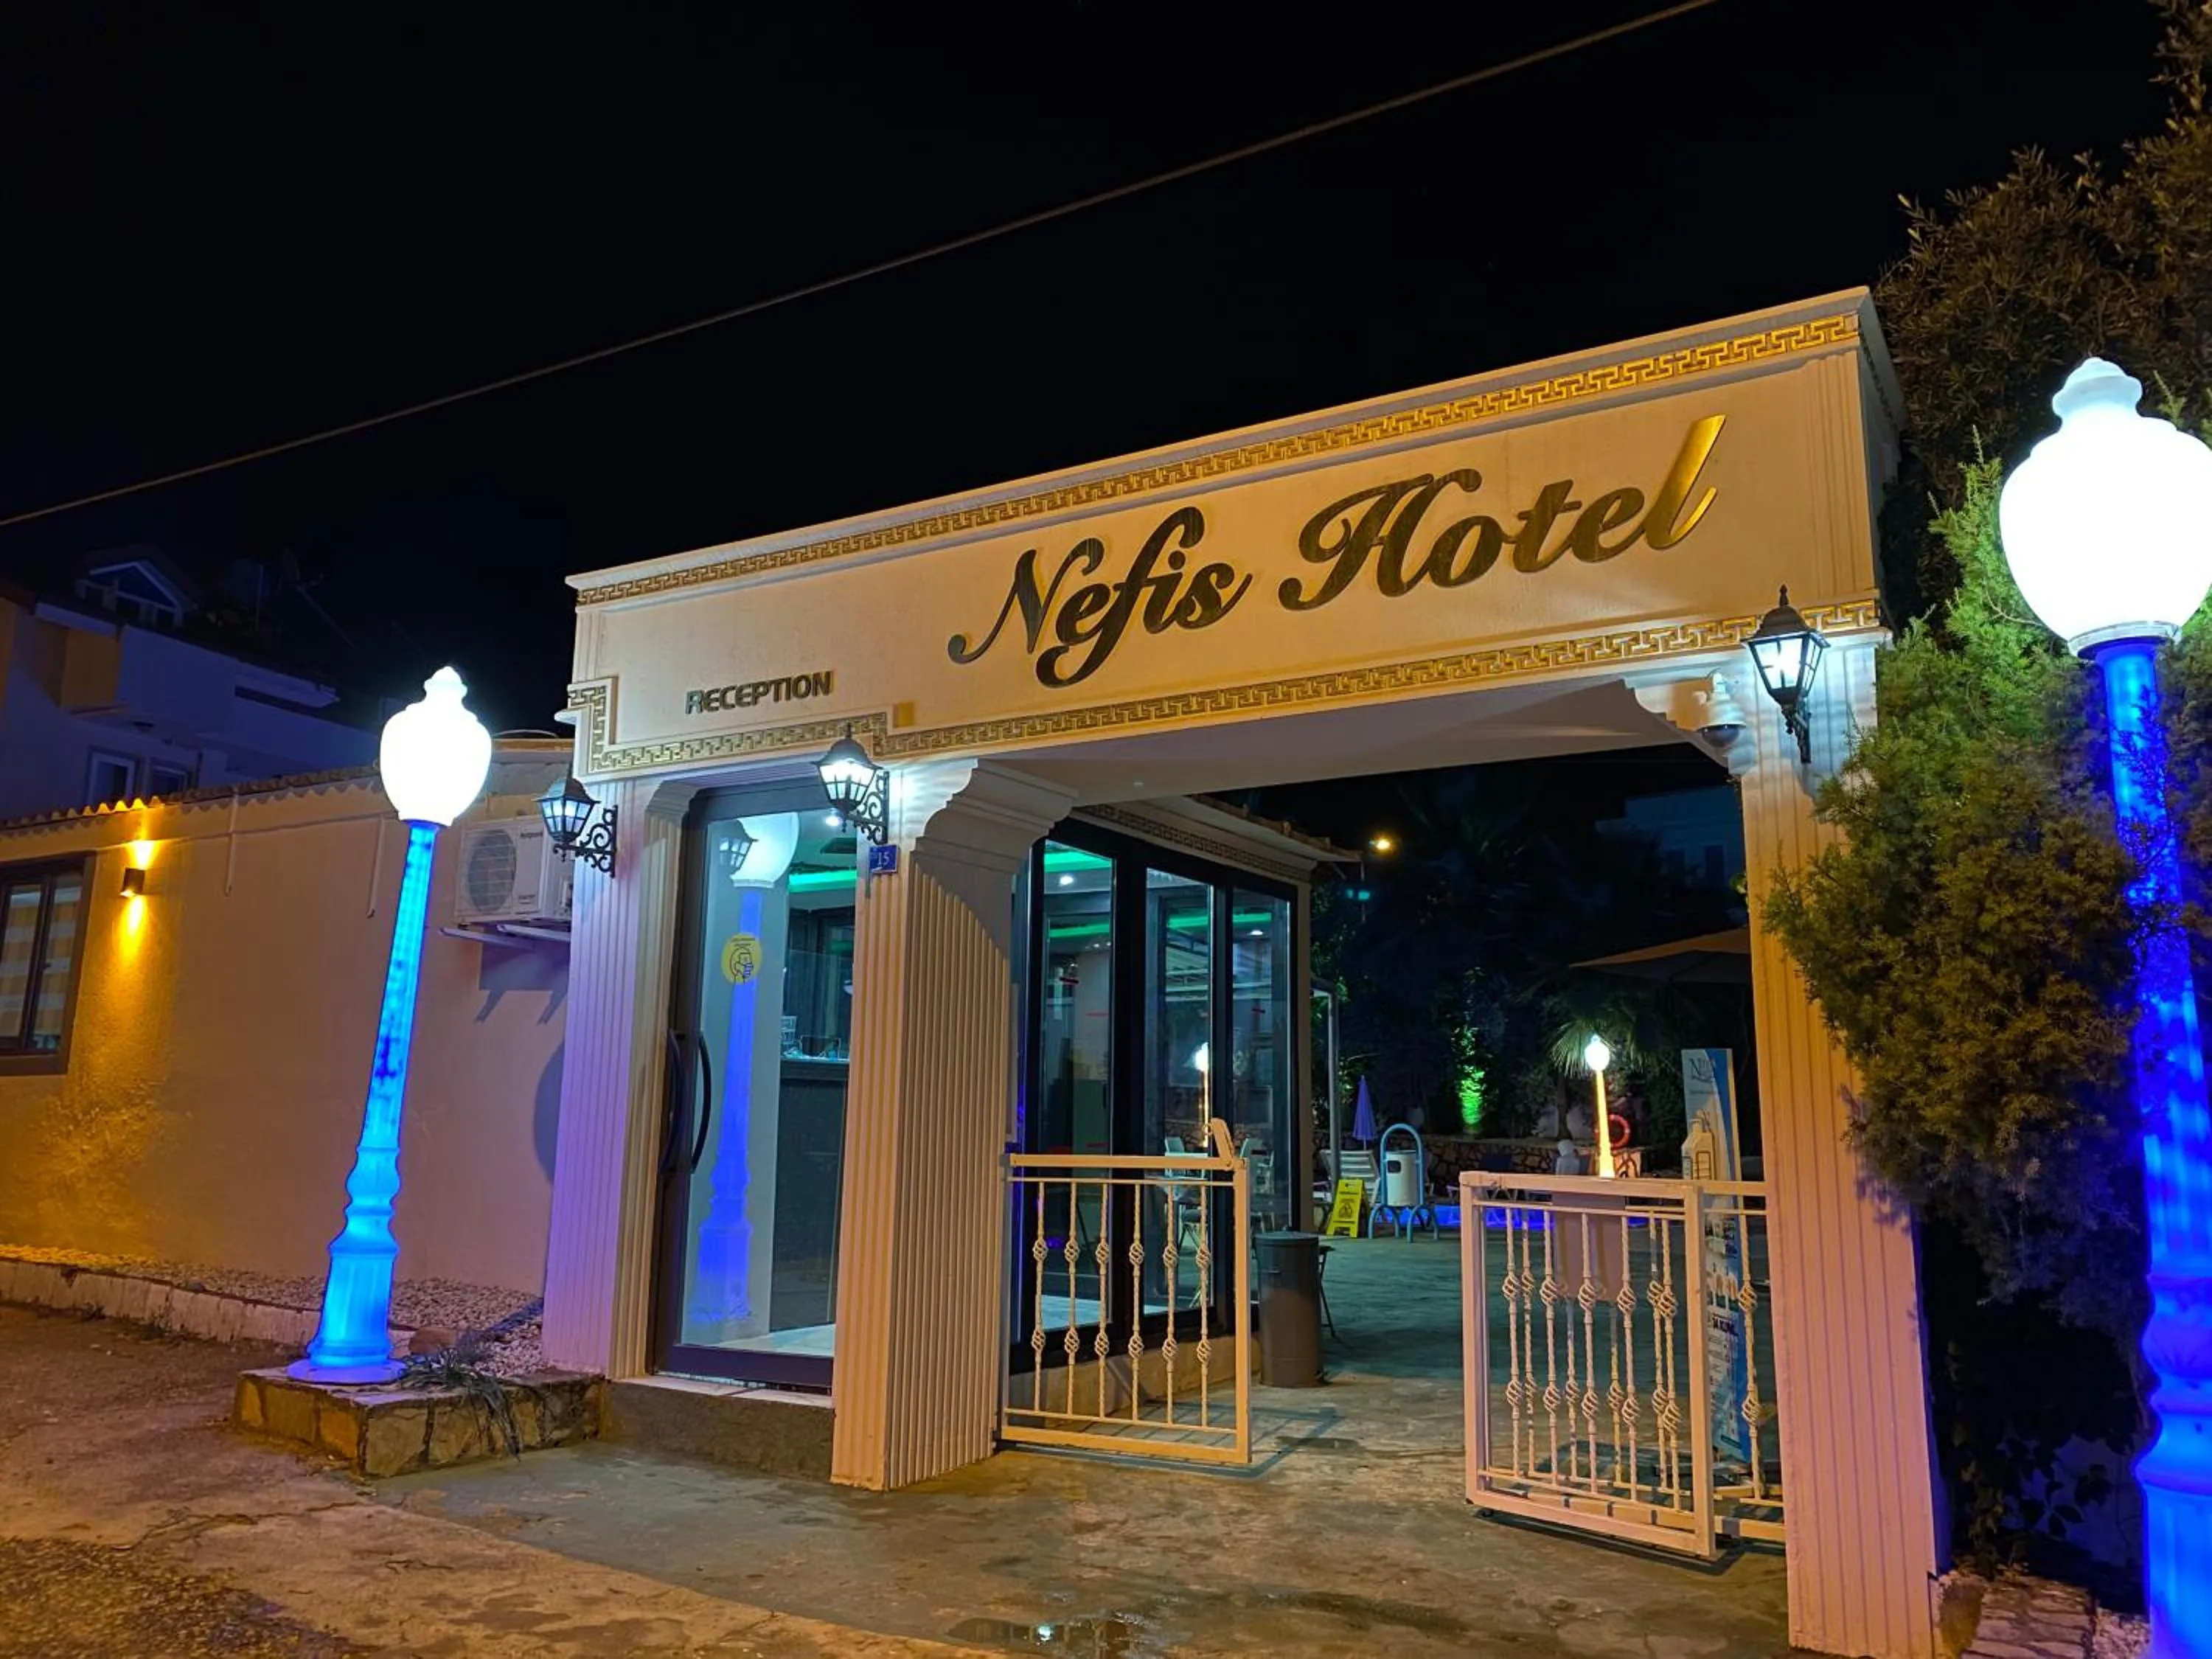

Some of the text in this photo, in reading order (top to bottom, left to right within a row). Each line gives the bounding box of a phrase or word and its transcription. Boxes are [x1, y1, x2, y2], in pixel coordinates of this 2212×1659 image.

[947, 413, 1728, 689] Nefis Hotel
[685, 670, 834, 715] RECEPTION
